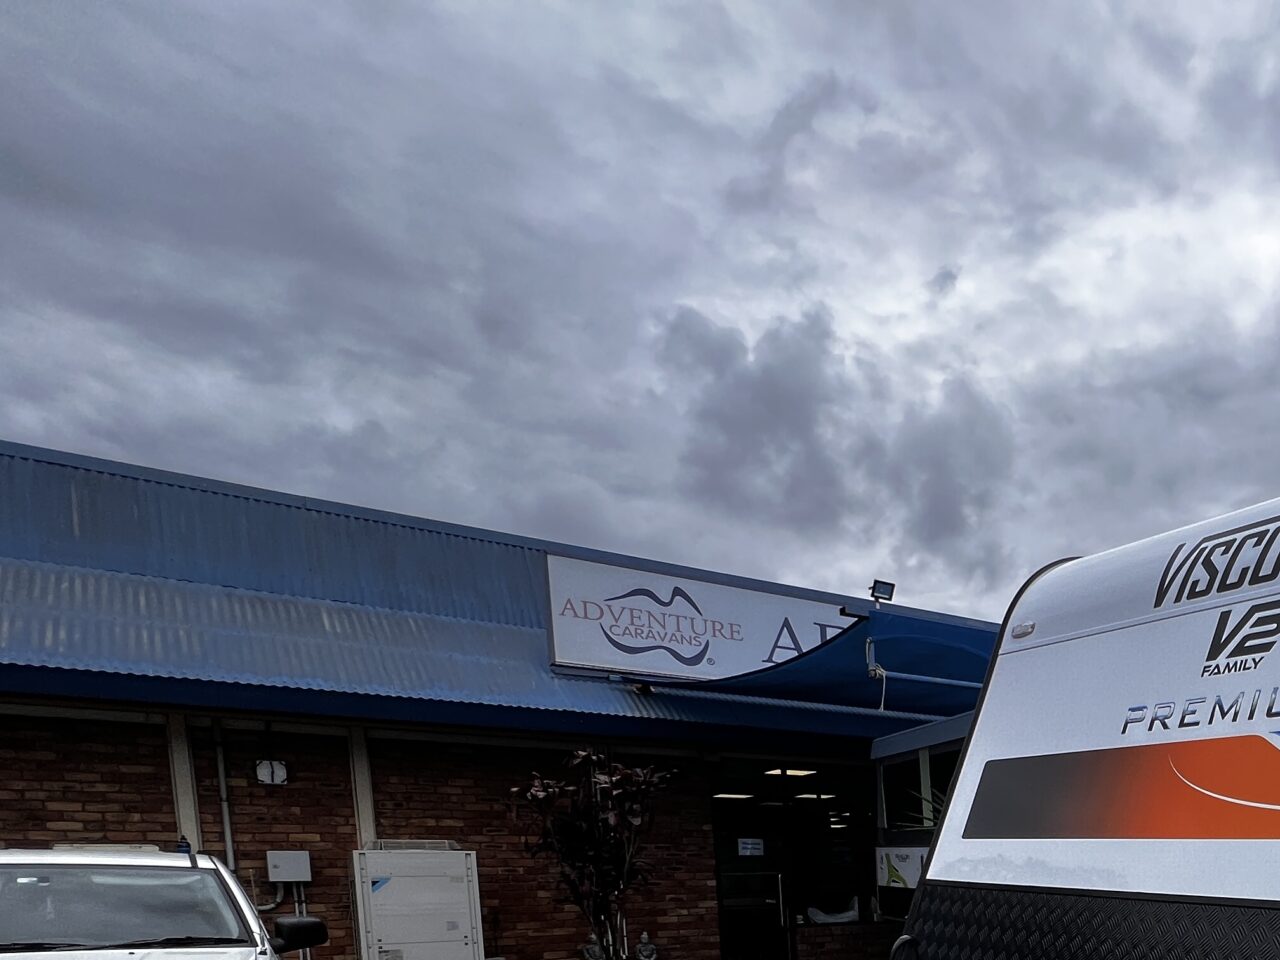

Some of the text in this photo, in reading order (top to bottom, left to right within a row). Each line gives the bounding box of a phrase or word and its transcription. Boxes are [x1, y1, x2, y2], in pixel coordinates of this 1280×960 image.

[560, 598, 745, 641] ADVENTURE
[609, 624, 702, 647] CARAVANS
[1200, 656, 1265, 678] FAMILY
